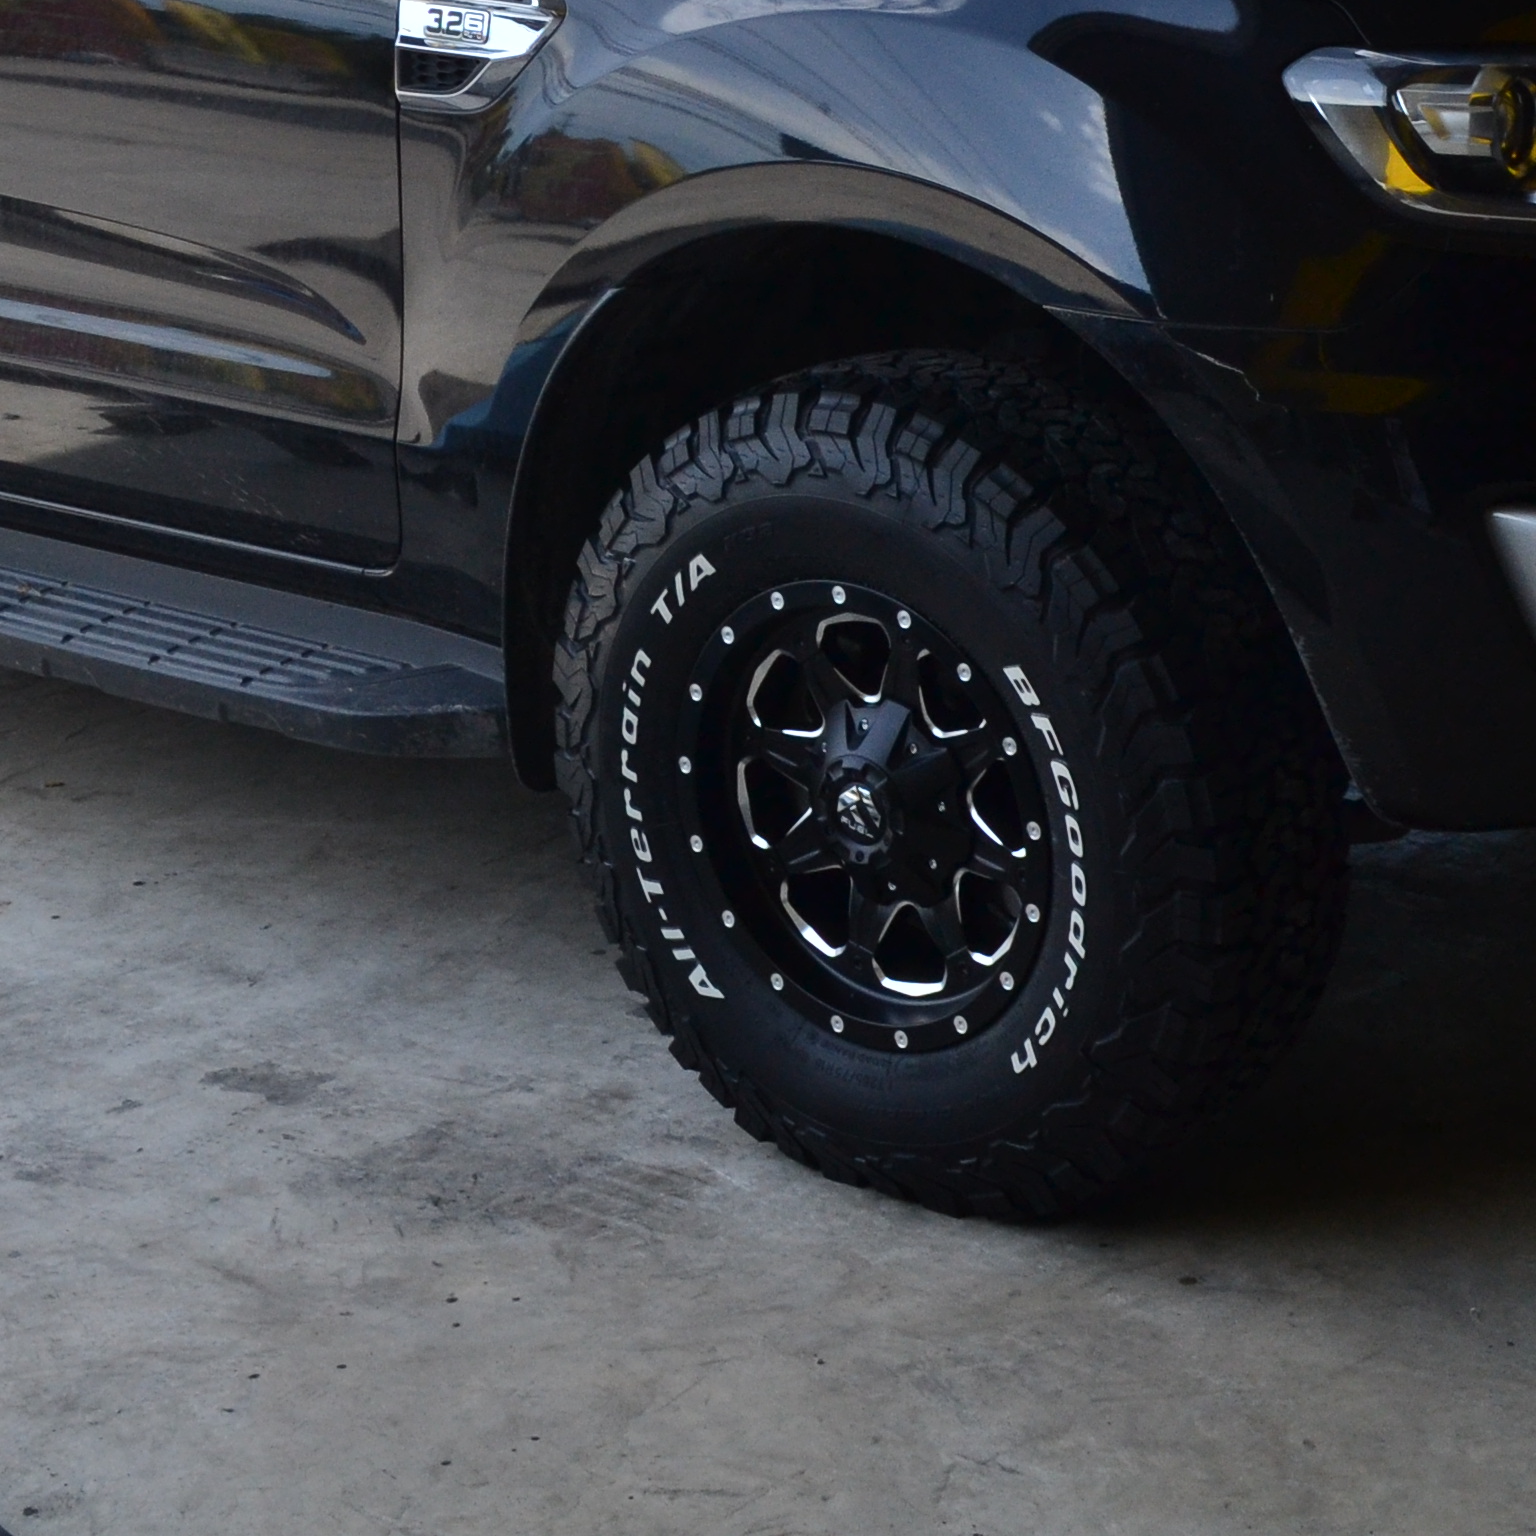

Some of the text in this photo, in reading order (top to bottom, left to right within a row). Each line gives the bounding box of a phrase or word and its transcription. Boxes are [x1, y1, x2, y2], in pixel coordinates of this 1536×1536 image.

[426, 8, 464, 37] 3.2
[621, 553, 725, 1000] All-Terrain T/A
[1003, 665, 1087, 1074] BFGoodrich
